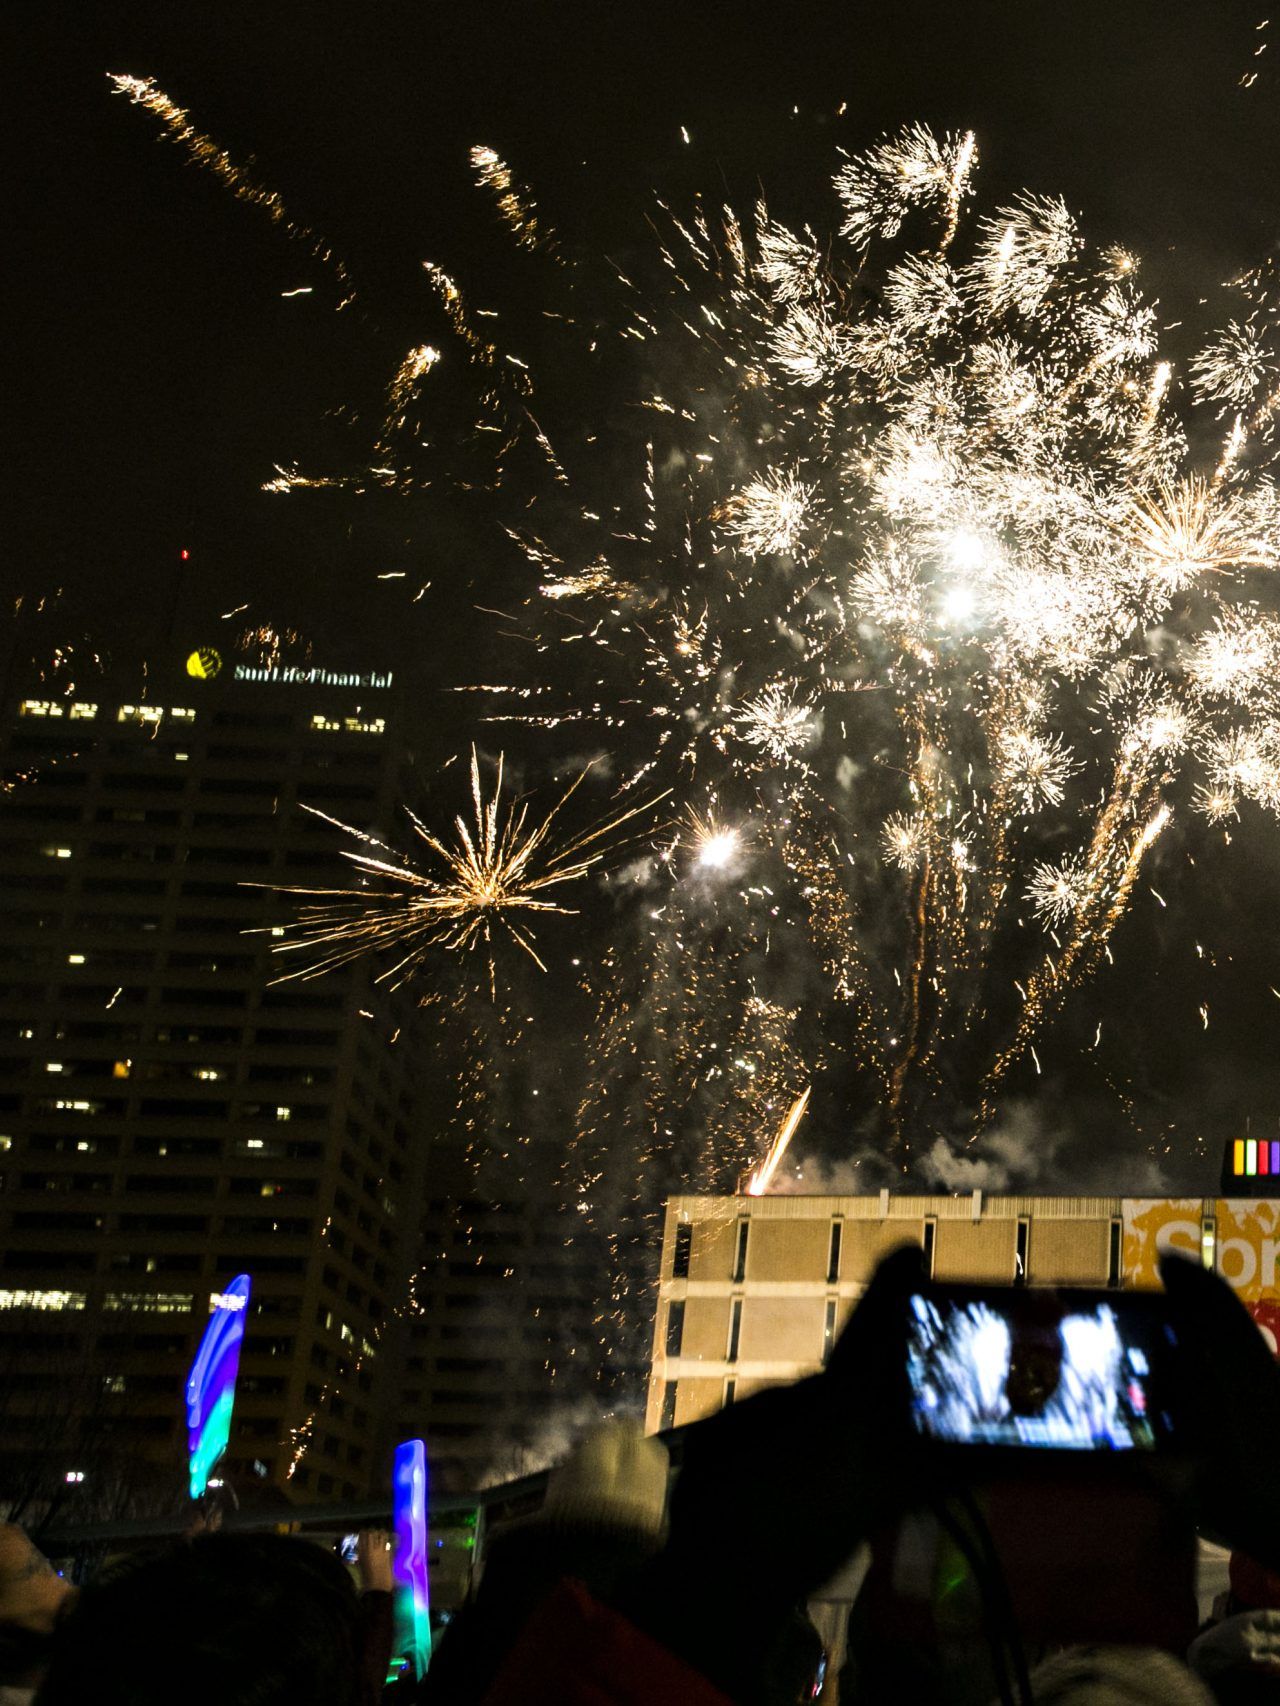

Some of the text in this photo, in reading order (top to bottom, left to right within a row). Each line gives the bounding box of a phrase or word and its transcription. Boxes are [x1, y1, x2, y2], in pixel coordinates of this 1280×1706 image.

[234, 664, 393, 688] Sun Life Financial
